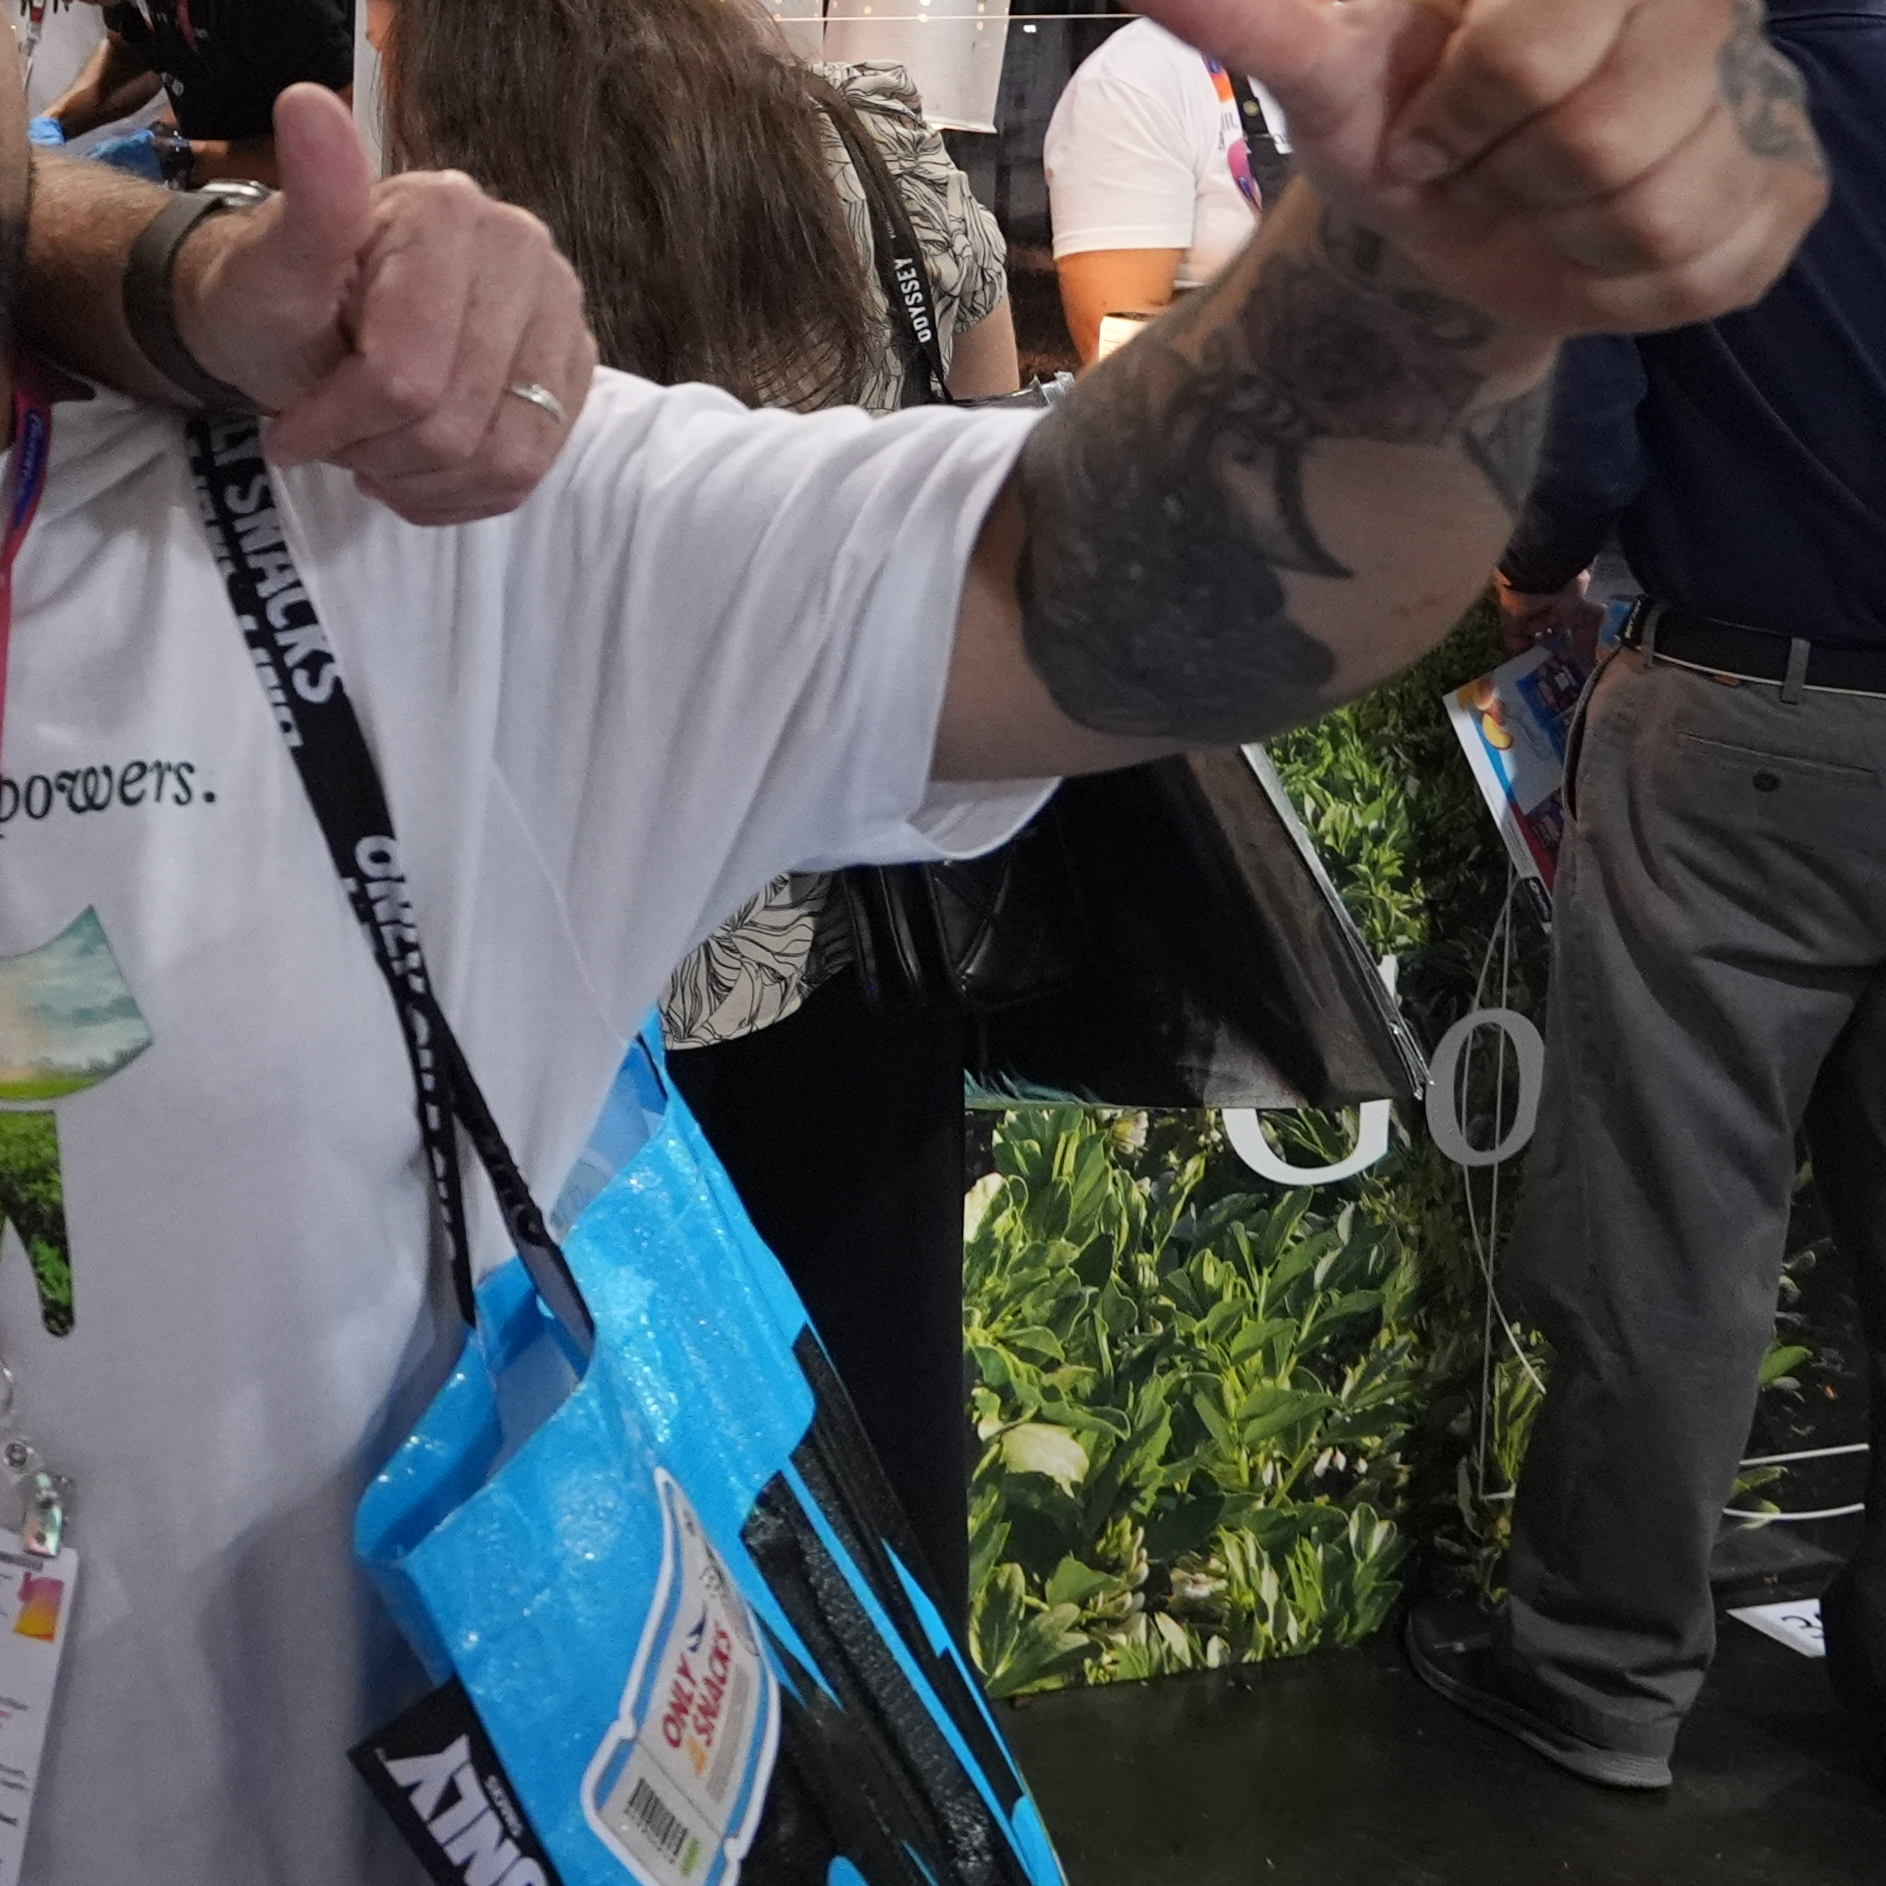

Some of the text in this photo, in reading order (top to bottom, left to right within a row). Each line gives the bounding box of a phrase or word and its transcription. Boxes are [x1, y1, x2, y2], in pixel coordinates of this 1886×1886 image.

[893, 257, 931, 343] ODYSSEY
[225, 471, 343, 705] SNACKS
[661, 1652, 689, 1749] ONLY
[693, 1626, 733, 1748] SNACKS
